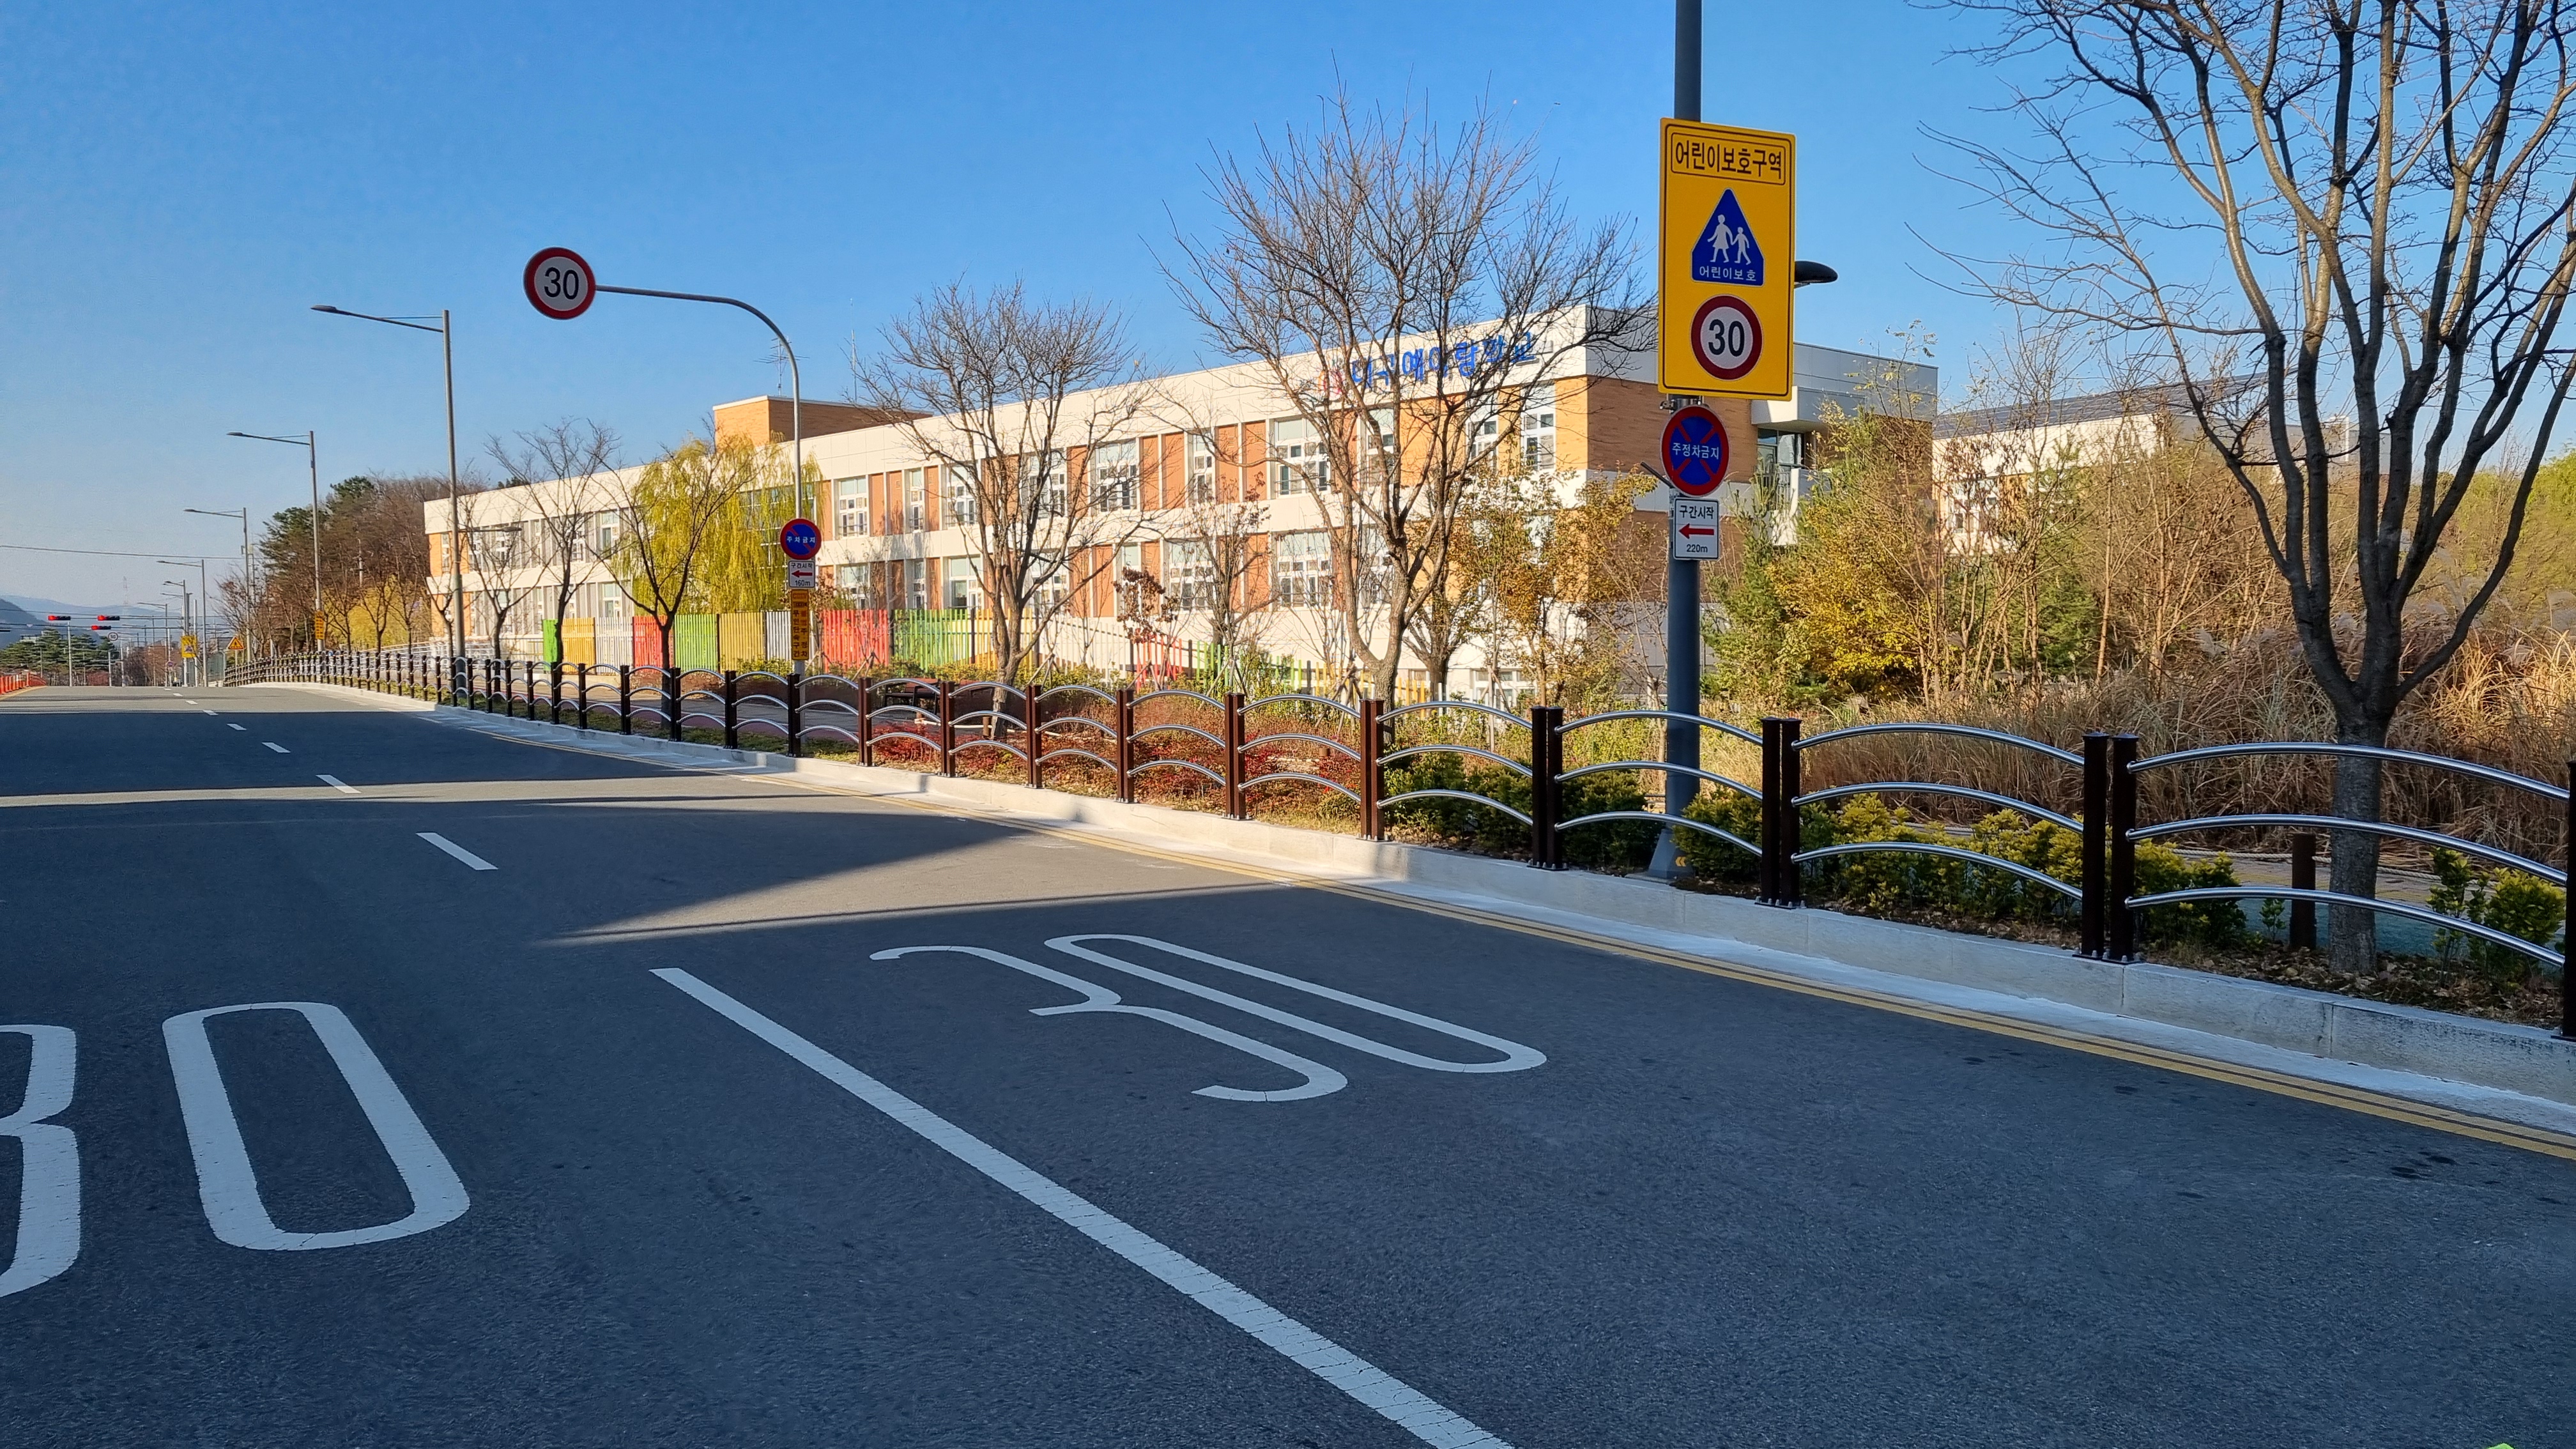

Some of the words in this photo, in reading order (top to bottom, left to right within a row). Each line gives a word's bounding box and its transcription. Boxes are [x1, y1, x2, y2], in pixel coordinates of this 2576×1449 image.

[1675, 140, 1782, 180] 어린이보호구역
[544, 266, 579, 300] 30
[1699, 266, 1756, 282] 어린이보호
[1708, 319, 1745, 357] 30
[1672, 442, 1719, 459] 주정차금지
[1679, 505, 1715, 519] 구간시작
[1686, 544, 1708, 553] 220m
[869, 933, 1547, 1102] 30
